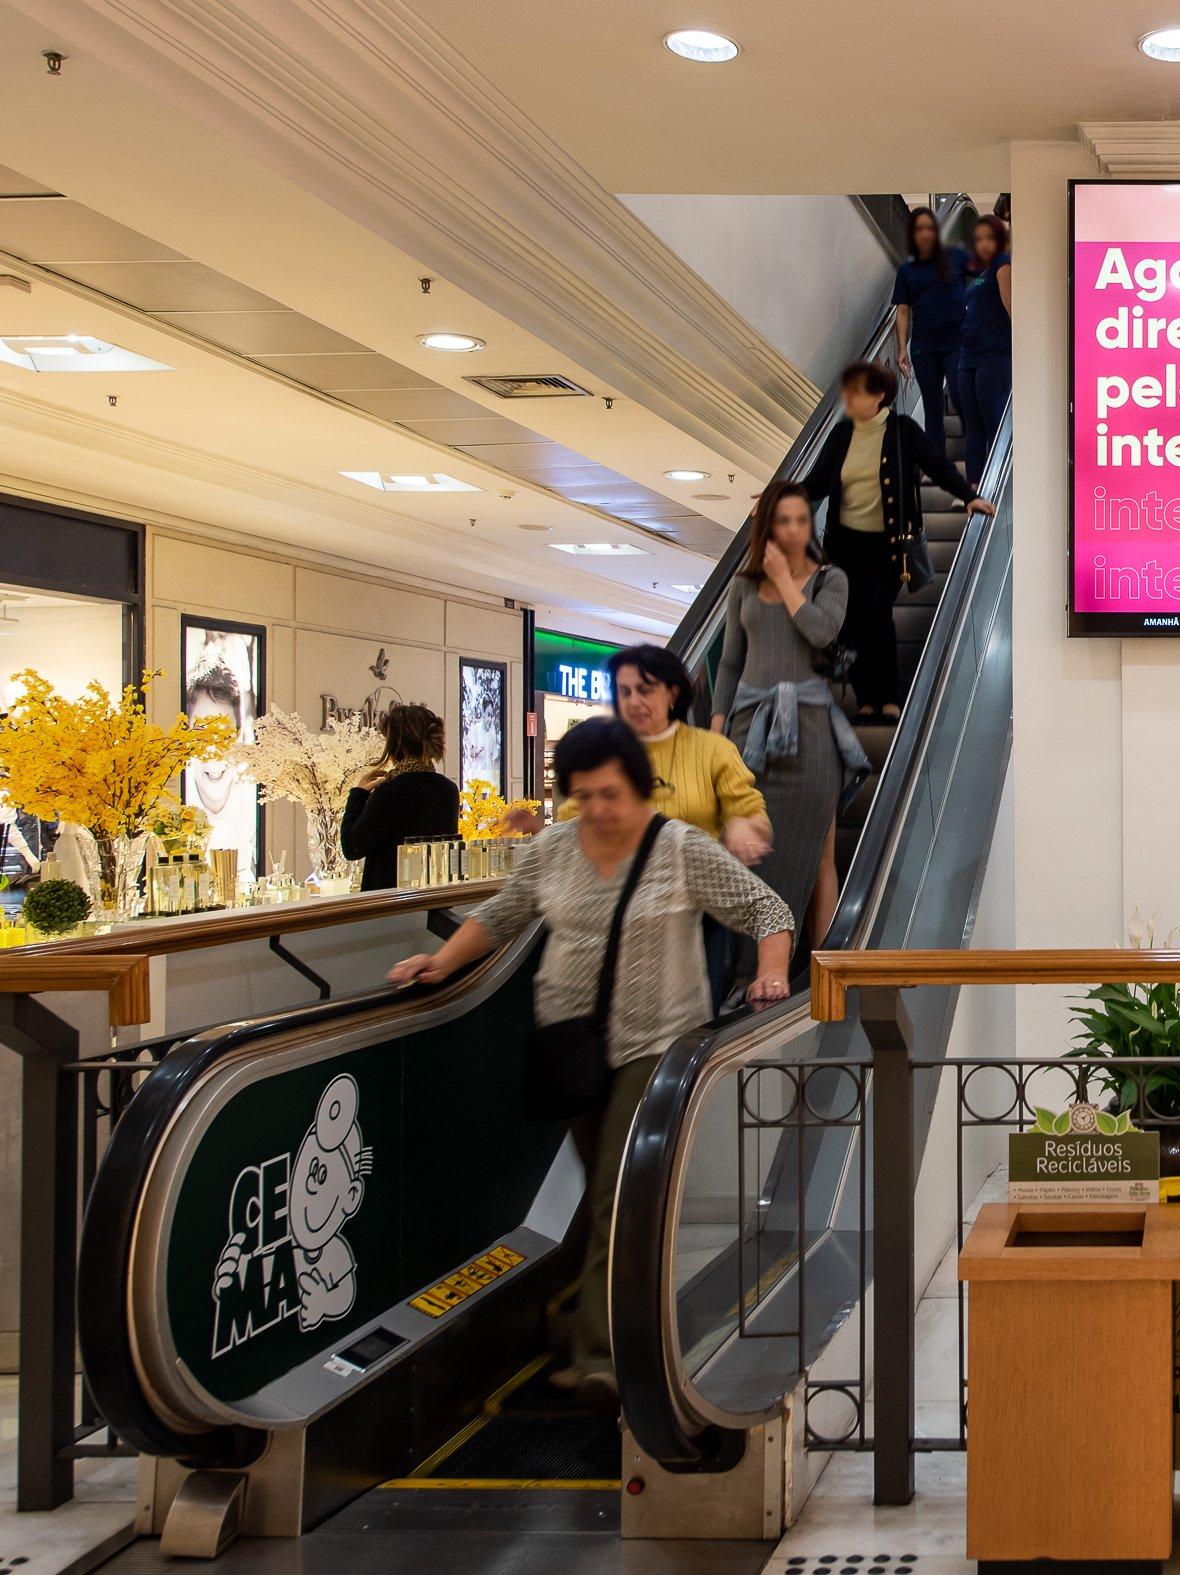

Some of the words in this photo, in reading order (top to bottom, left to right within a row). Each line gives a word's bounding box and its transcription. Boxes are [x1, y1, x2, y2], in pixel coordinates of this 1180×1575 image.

[1144, 617, 1179, 626] AMANHÃ
[559, 664, 587, 699] THE
[1045, 1139, 1123, 1158] Resíduos
[1036, 1156, 1131, 1175] Recicláveis
